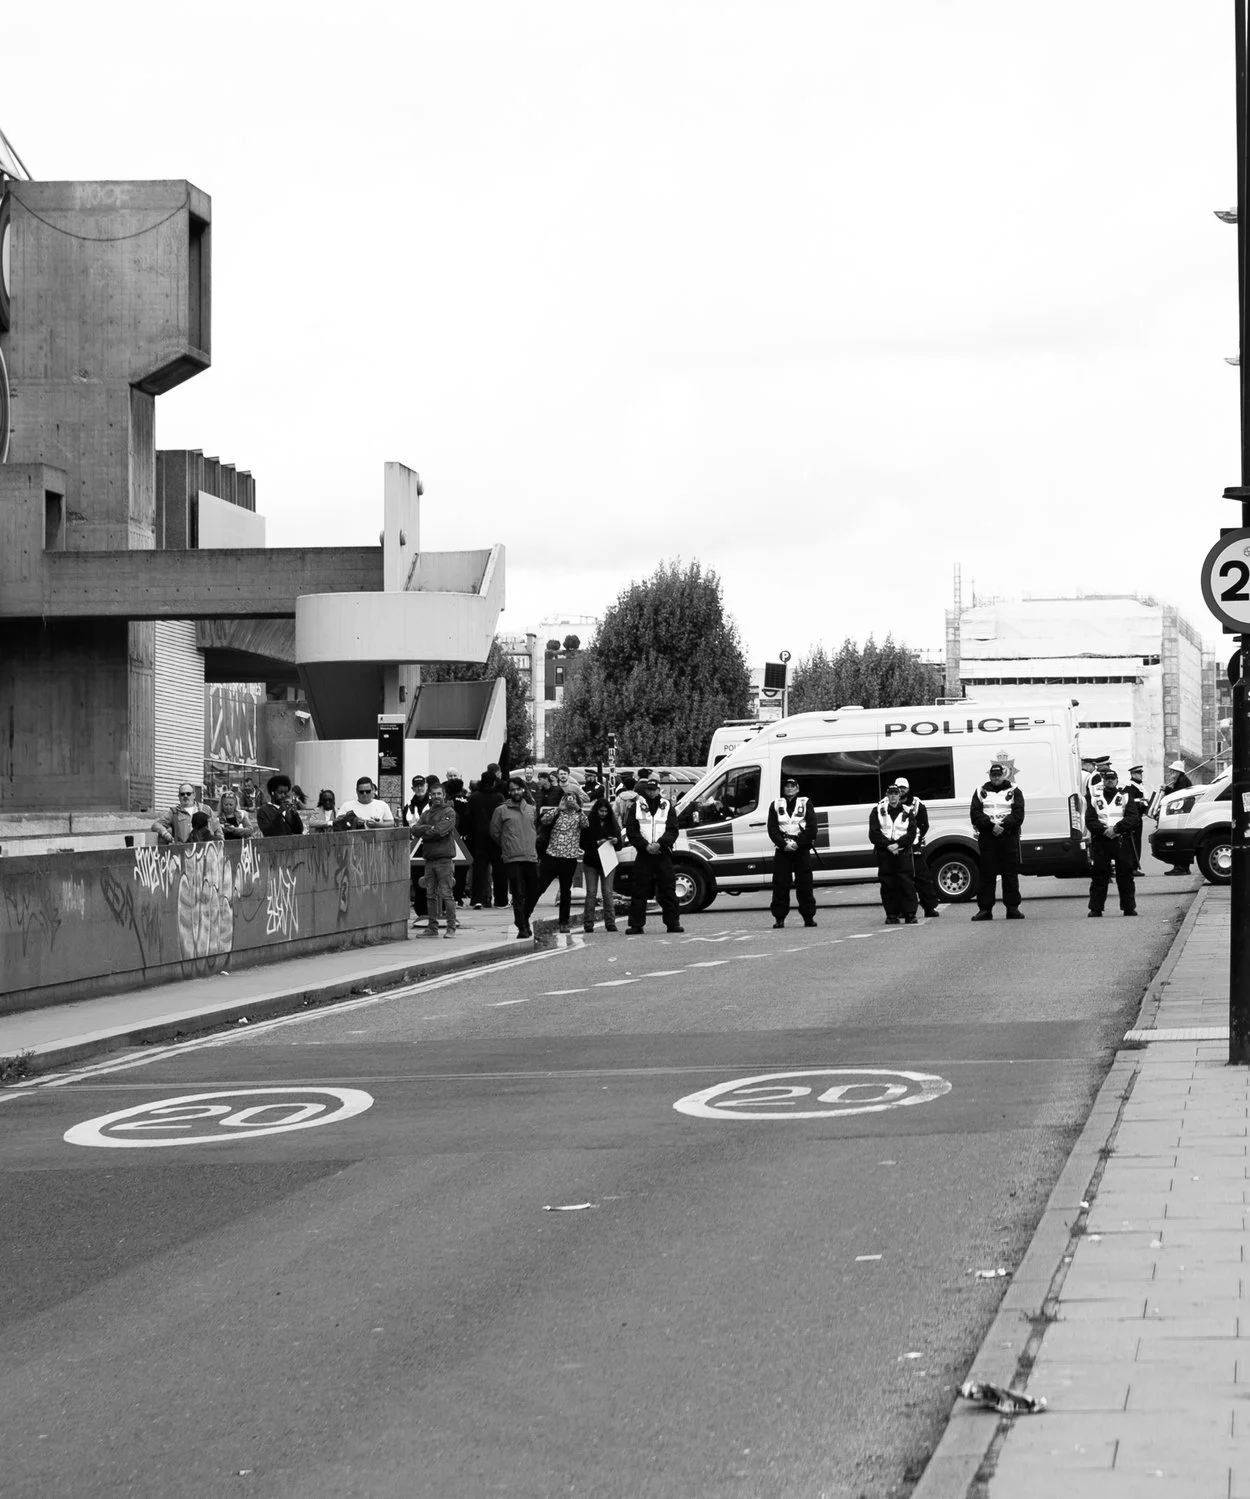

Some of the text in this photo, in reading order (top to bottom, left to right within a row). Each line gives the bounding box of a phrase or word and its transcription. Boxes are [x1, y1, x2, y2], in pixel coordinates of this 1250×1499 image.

[885, 717, 1031, 737] POLICE
[714, 1083, 908, 1106] 20
[109, 1103, 327, 1130] 20
